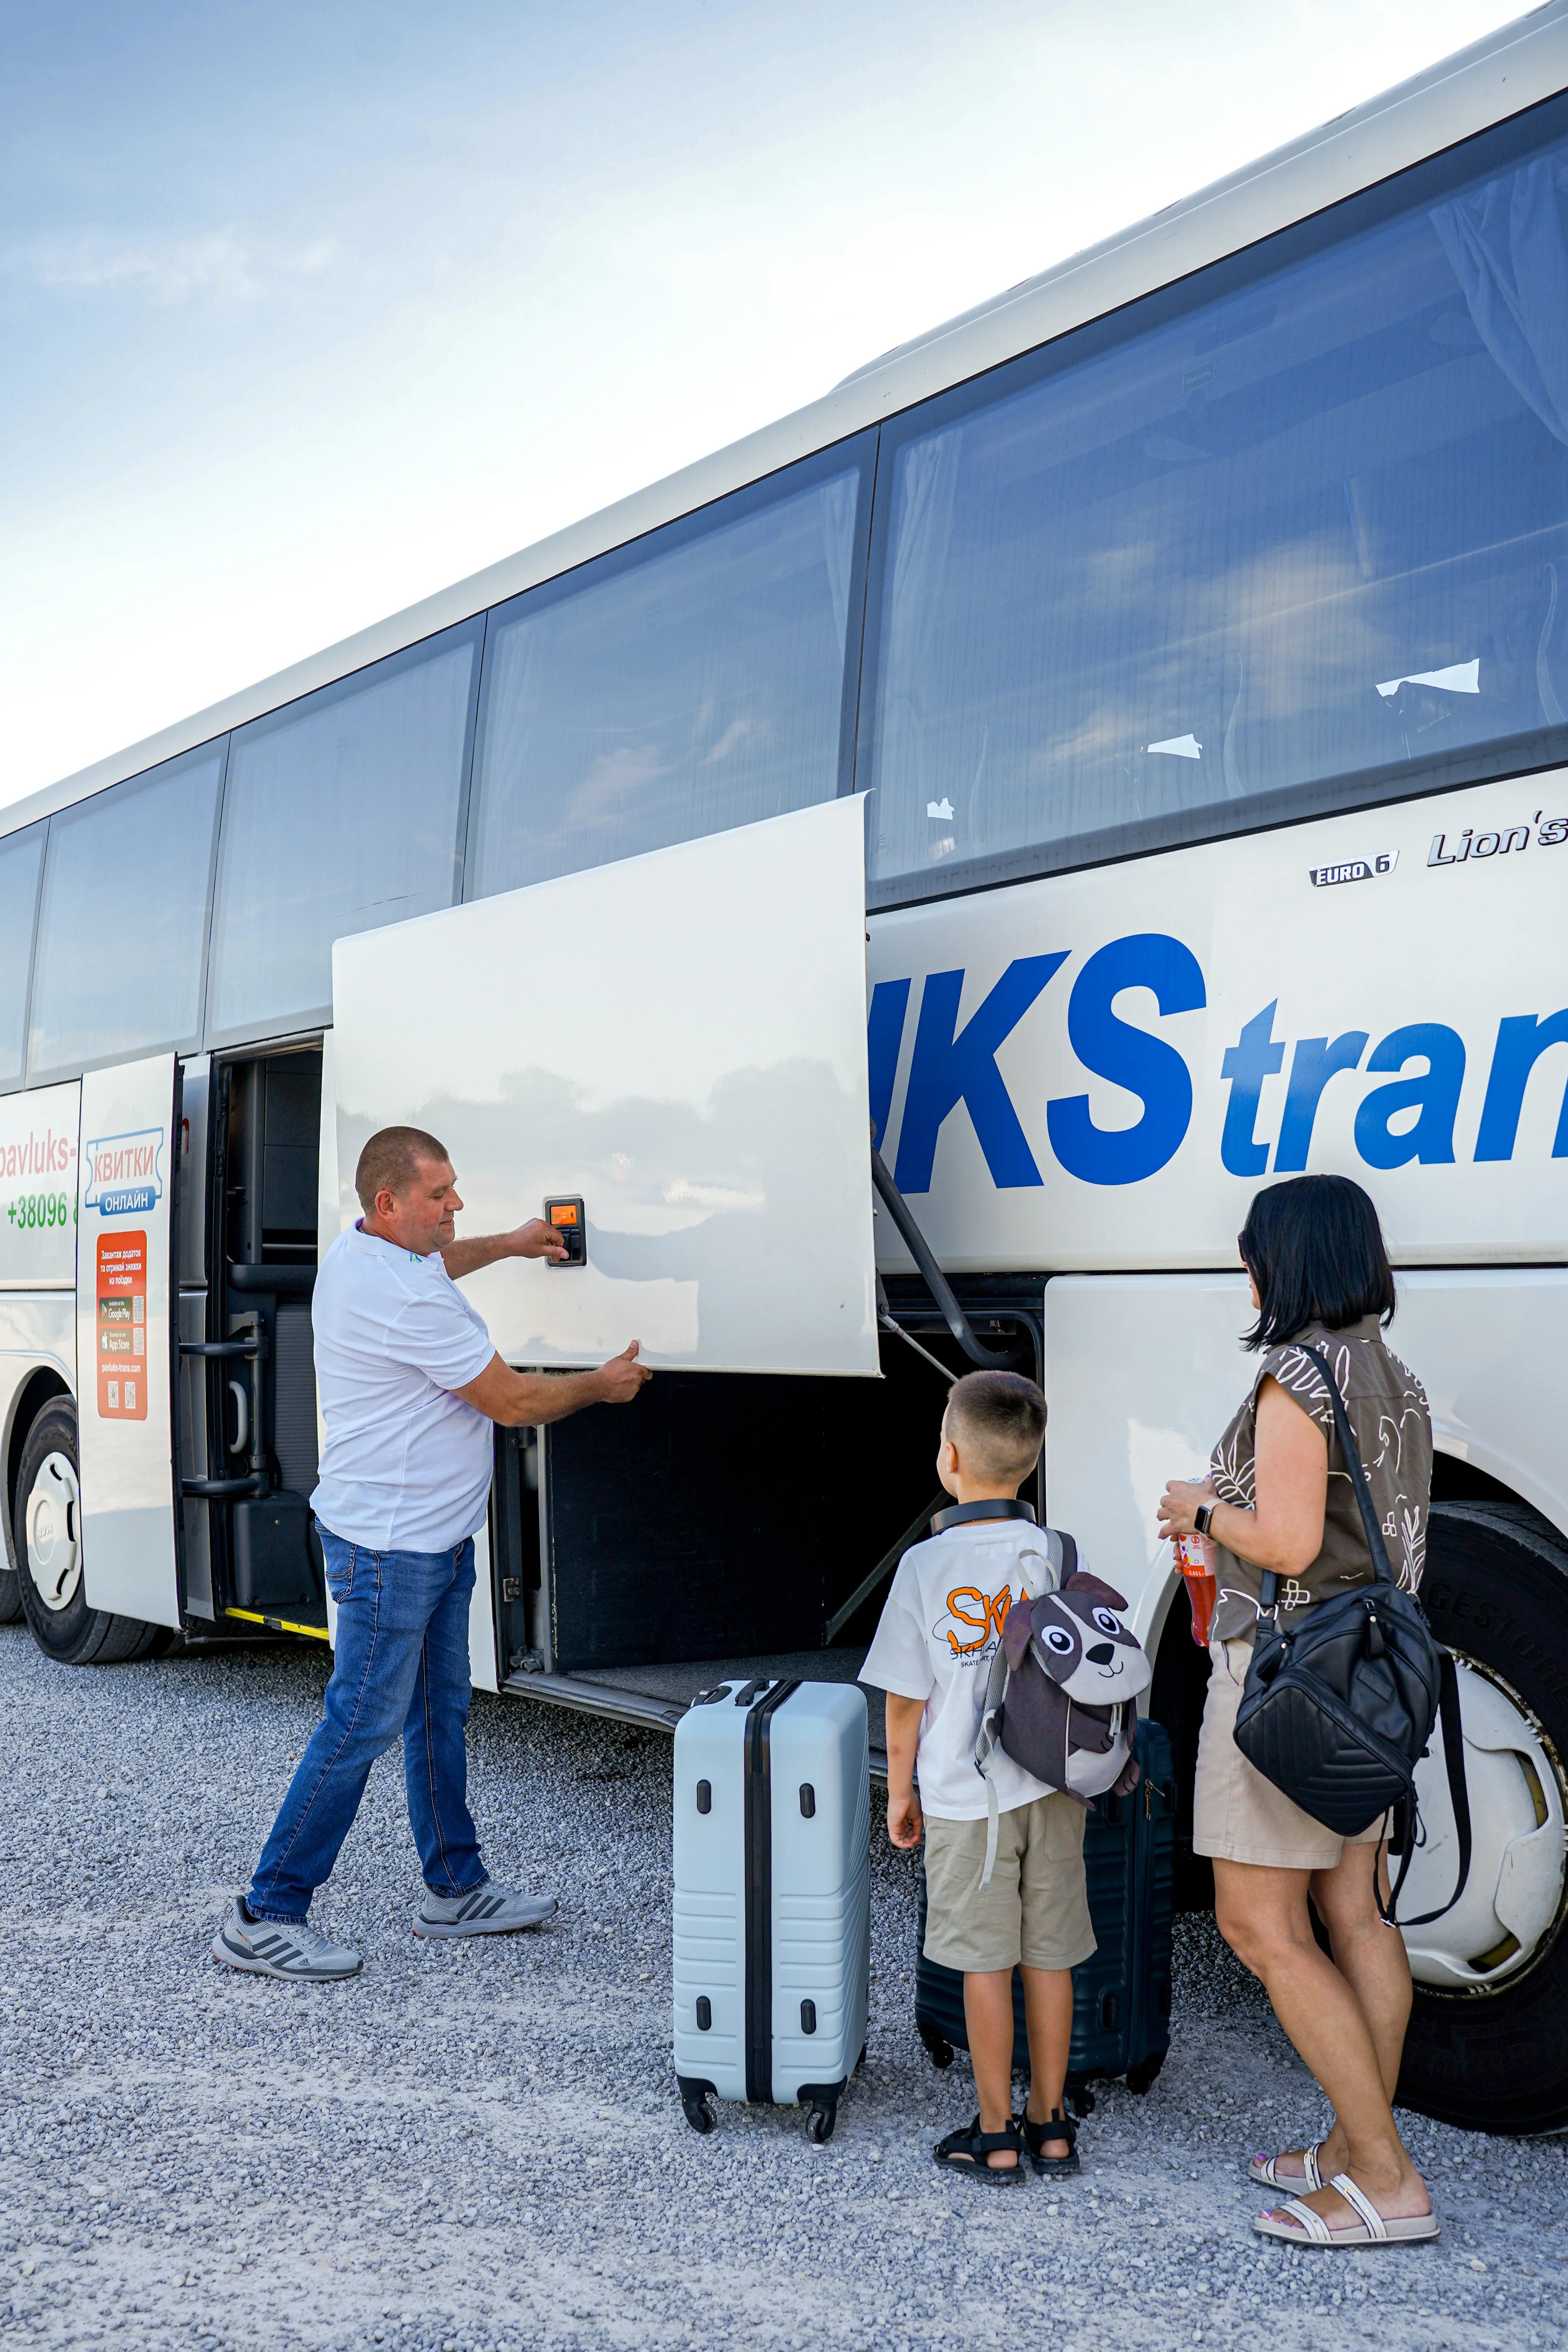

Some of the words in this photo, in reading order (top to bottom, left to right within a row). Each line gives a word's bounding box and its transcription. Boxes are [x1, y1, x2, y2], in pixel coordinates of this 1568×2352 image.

[1427, 810, 1568, 867] Lion's
[1316, 863, 1365, 886] EURO
[1376, 854, 1390, 874] 6
[94, 1145, 153, 1183] КВИТКИ
[105, 1189, 148, 1212] ОНЛАЙН
[8, 1192, 67, 1228] +38096
[101, 1250, 122, 1260] Завантаж
[122, 1249, 141, 1260] додаток
[106, 1262, 125, 1274] отримай
[125, 1263, 142, 1271] знижки
[109, 1277, 115, 1285] на
[115, 1275, 132, 1286] поїздки
[108, 1308, 122, 1321] Google
[122, 1308, 130, 1320] Play
[109, 1339, 118, 1352] App
[118, 1339, 130, 1350] Store
[102, 1362, 141, 1373] pavluks-trans.com
